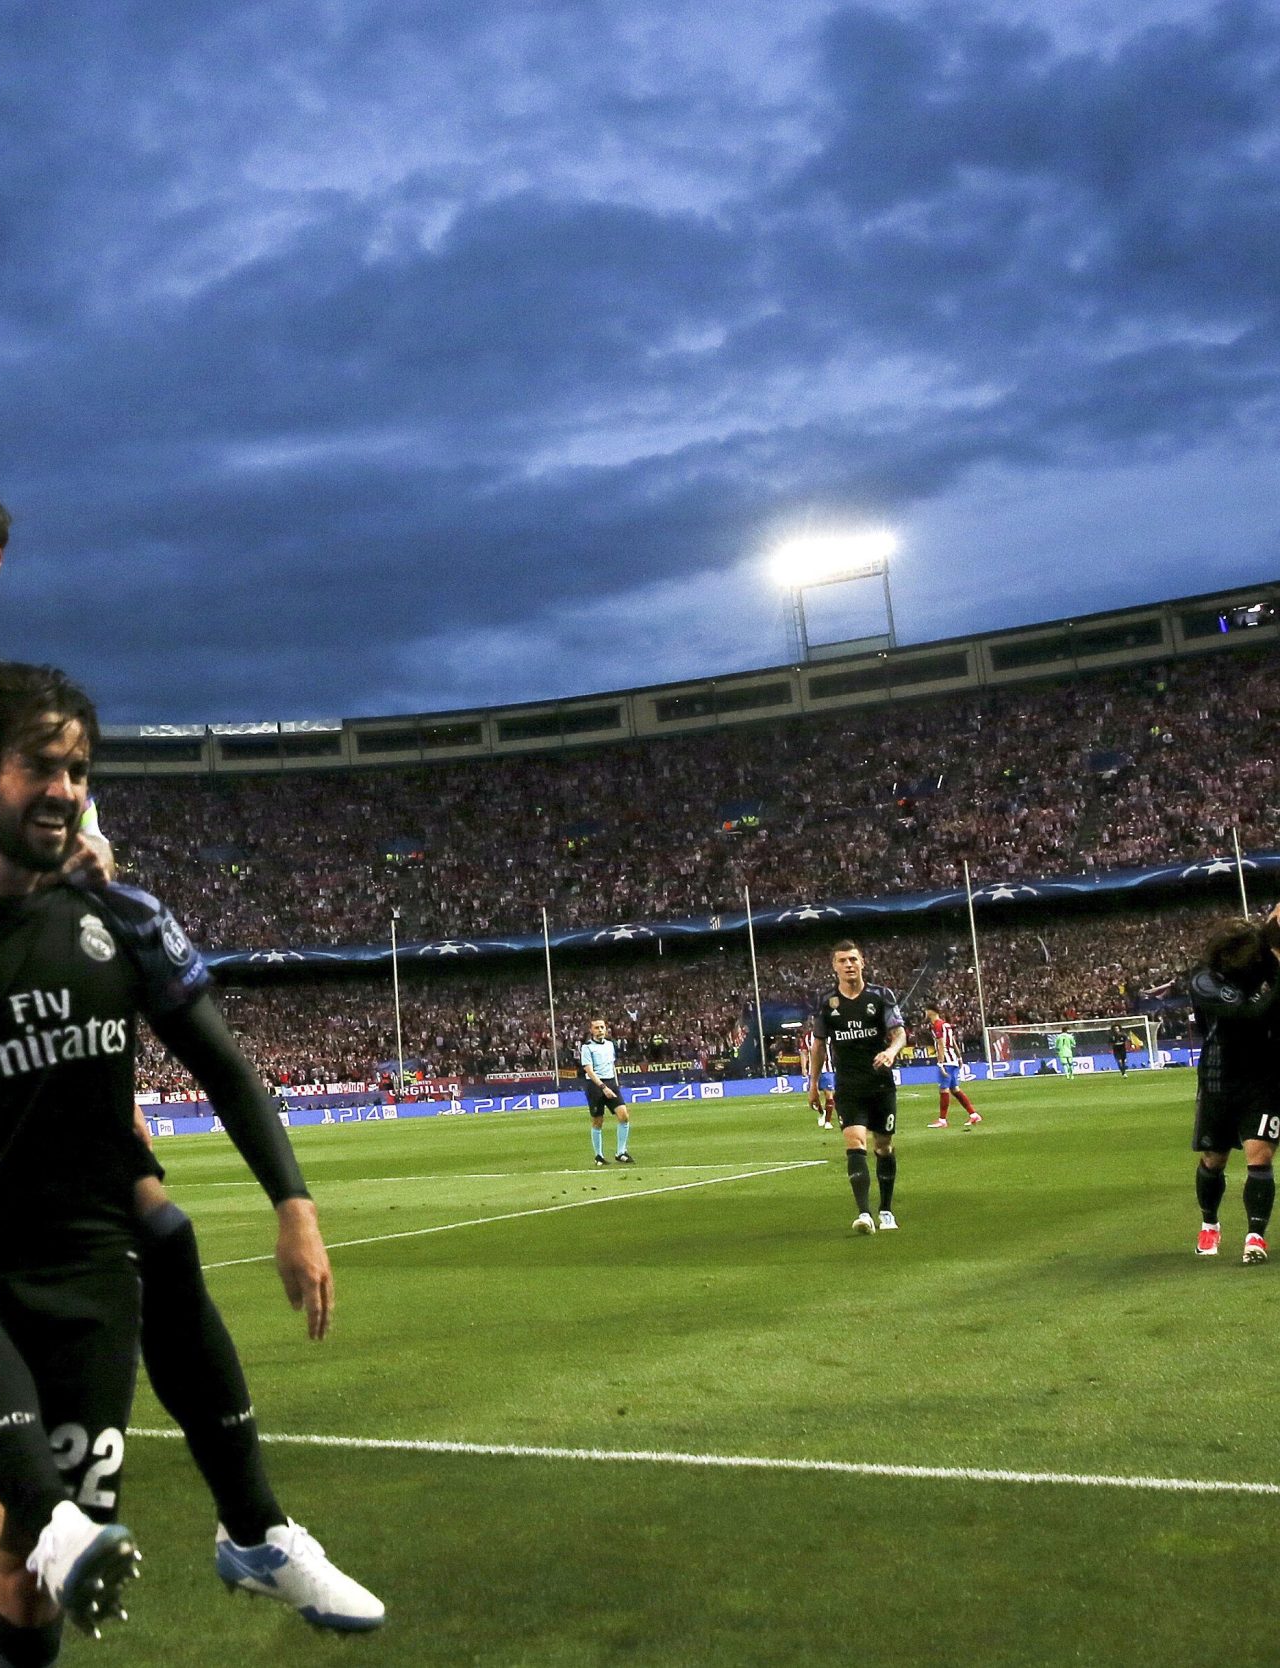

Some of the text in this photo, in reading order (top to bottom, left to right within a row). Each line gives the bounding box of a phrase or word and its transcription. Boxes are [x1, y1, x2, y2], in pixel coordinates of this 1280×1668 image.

[9, 988, 70, 1023] Fly
[835, 1027, 878, 1040] Emirates
[847, 1020, 862, 1029] Fly
[631, 1084, 720, 1103] PS4 Pro
[474, 1095, 556, 1113] PS4 Pro
[339, 1106, 396, 1122] PS4 Pro
[885, 1113, 895, 1131] 8
[160, 1122, 172, 1132] Pro
[1257, 1113, 1280, 1139] 19
[49, 1422, 125, 1508] 22
